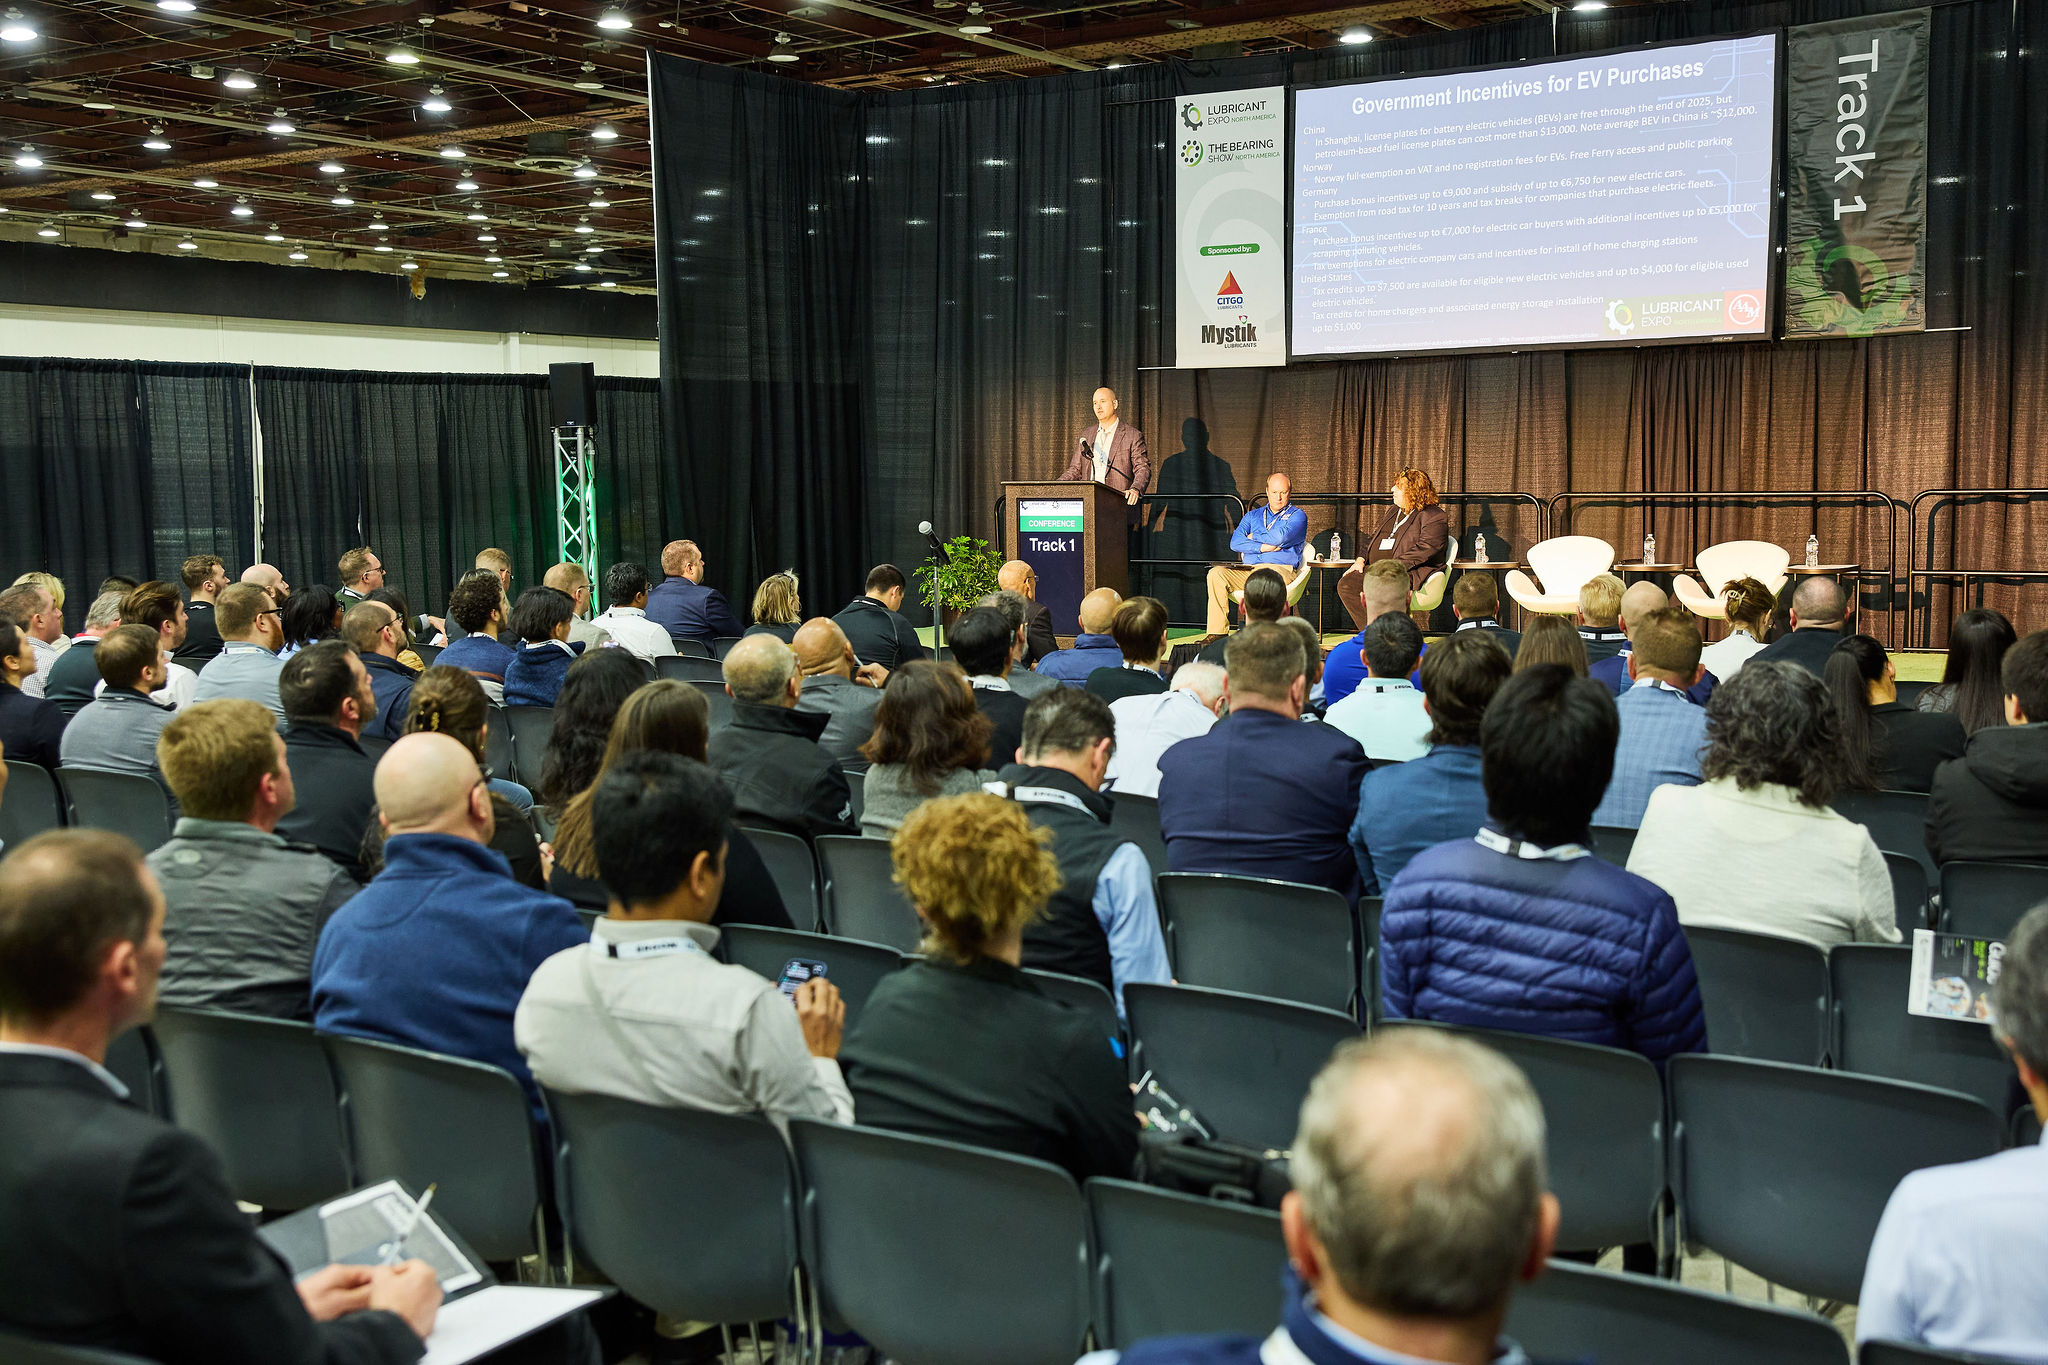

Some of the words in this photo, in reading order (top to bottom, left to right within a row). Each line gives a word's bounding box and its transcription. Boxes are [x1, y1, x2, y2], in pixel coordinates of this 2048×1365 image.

[1352, 87, 1451, 114] Government
[1456, 80, 1543, 103] Incentives
[1548, 75, 1572, 92] for
[1577, 70, 1602, 89] EV
[1607, 62, 1704, 86] Purchases
[1207, 100, 1267, 116] LUBRICANT
[1833, 38, 1879, 184] Track
[1207, 115, 1230, 126] EXPO
[1231, 115, 1251, 123] NORTH
[1251, 113, 1277, 121] AMERICA
[1315, 138, 1323, 146] In
[1324, 134, 1362, 145] Shanghai,
[1364, 132, 1392, 141] license
[1393, 129, 1418, 140] plates
[1420, 127, 1432, 135] for
[1433, 125, 1464, 134] battery
[1465, 120, 1496, 130] electric
[1498, 116, 1533, 127] vehicles
[1534, 112, 1562, 125] (BEVs)
[1580, 110, 1598, 119] free
[1600, 105, 1636, 117] through
[1638, 103, 1654, 113] the
[1655, 101, 1673, 111] end
[1675, 100, 1685, 109] of
[1687, 97, 1713, 108] 2025,
[1716, 96, 1732, 105] but
[1303, 126, 1325, 134] China
[1315, 144, 1382, 160] petroleum-based
[1384, 142, 1400, 151] fuel
[1401, 141, 1429, 150] license
[1431, 138, 1456, 149] plates
[1474, 134, 1492, 142] cost
[1494, 132, 1517, 140] more
[1519, 129, 1538, 138] than
[1540, 125, 1578, 137] $13,000.
[1580, 123, 1602, 132] Note
[1604, 120, 1639, 130] average
[1641, 116, 1659, 126] BEV
[1661, 115, 1670, 124] in
[1672, 113, 1699, 123] China
[1701, 112, 1709, 120] is
[1208, 142, 1228, 154] THE
[1229, 139, 1274, 151] BEARING
[1208, 153, 1234, 163] SHOW
[1255, 151, 1280, 159] AMERICA
[1314, 175, 1345, 183] Norway
[1346, 171, 1359, 180] full
[1361, 168, 1403, 179] exemption
[1418, 165, 1433, 173] VAT
[1435, 162, 1451, 172] and
[1465, 158, 1513, 171] registration
[1515, 156, 1533, 164] fees
[1535, 154, 1548, 163] for
[1550, 153, 1567, 161] EVs.
[1570, 151, 1589, 159] Free
[1591, 149, 1615, 158] Ferry
[1616, 146, 1646, 155] access
[1647, 142, 1665, 152] and
[1667, 140, 1695, 153] public
[1697, 137, 1733, 150] parking
[1303, 163, 1333, 172] Norway
[1302, 188, 1338, 197] Germany
[1314, 198, 1349, 208] Purchase
[1351, 196, 1376, 205] bonus
[1377, 192, 1418, 202] incentives
[1419, 192, 1430, 201] up
[1432, 190, 1441, 198] to
[1443, 187, 1471, 197] €9,000
[1473, 185, 1489, 194] and
[1490, 182, 1523, 193] subsidy
[1524, 181, 1534, 190] of
[1536, 182, 1547, 191] up
[1549, 180, 1558, 188] to
[1560, 176, 1591, 187] €6,750
[1592, 175, 1605, 184] for
[1608, 175, 1627, 183] new
[1629, 170, 1662, 181] electric
[1664, 170, 1686, 178] cars.
[1314, 210, 1355, 221] Exemption
[1357, 209, 1376, 217] from
[1378, 206, 1397, 215] road
[1412, 204, 1424, 212] for
[1427, 203, 1437, 211] 10
[1438, 202, 1461, 212] years
[1462, 199, 1478, 208] and
[1480, 199, 1493, 207] tax
[1495, 195, 1523, 205] breaks
[1525, 194, 1537, 203] for
[1539, 191, 1586, 203] companies
[1588, 189, 1606, 198] that
[1609, 185, 1649, 198] purchase
[1651, 182, 1686, 192] electric
[1688, 180, 1716, 189] fleets.
[1833, 195, 1867, 221] 1
[1302, 226, 1327, 234] France
[1313, 236, 1348, 245] Purchase
[1350, 234, 1375, 242] bonus
[1376, 231, 1417, 240] incentives
[1419, 230, 1429, 239] up
[1441, 226, 1470, 236] €7,000
[1472, 225, 1484, 233] for
[1486, 222, 1518, 232] electric
[1535, 220, 1564, 230] buyers
[1565, 216, 1585, 226] with
[1587, 212, 1632, 224] additional
[1634, 210, 1680, 221] incentives
[1682, 210, 1694, 219] up
[1697, 208, 1706, 216] to
[1742, 203, 1756, 212] for
[1207, 245, 1242, 255] Sponsored
[1242, 245, 1252, 253] by:
[1312, 248, 1350, 259] scrapping
[1352, 245, 1387, 257] polluting
[1388, 242, 1423, 252] vehicles.
[1313, 262, 1325, 270] Tax
[1327, 259, 1372, 270] exemptions
[1374, 257, 1386, 266] for
[1388, 255, 1418, 265] electric
[1419, 254, 1457, 264] company
[1477, 249, 1493, 258] and
[1495, 247, 1538, 257] incentives
[1540, 246, 1552, 254] for
[1554, 243, 1580, 253] install
[1582, 242, 1591, 251] of
[1594, 241, 1619, 250] home
[1621, 238, 1660, 249] charging
[1662, 236, 1698, 245] stations
[1301, 274, 1327, 283] United
[1329, 273, 1352, 281] States
[1217, 296, 1243, 305] CITGO
[1641, 298, 1724, 315] LUBRICANT
[1641, 315, 1673, 328] EXPO
[1201, 323, 1257, 345] Mystik
[1028, 519, 1076, 528] CONFERENCE
[1029, 537, 1067, 552] Track
[1068, 538, 1075, 552] 1
